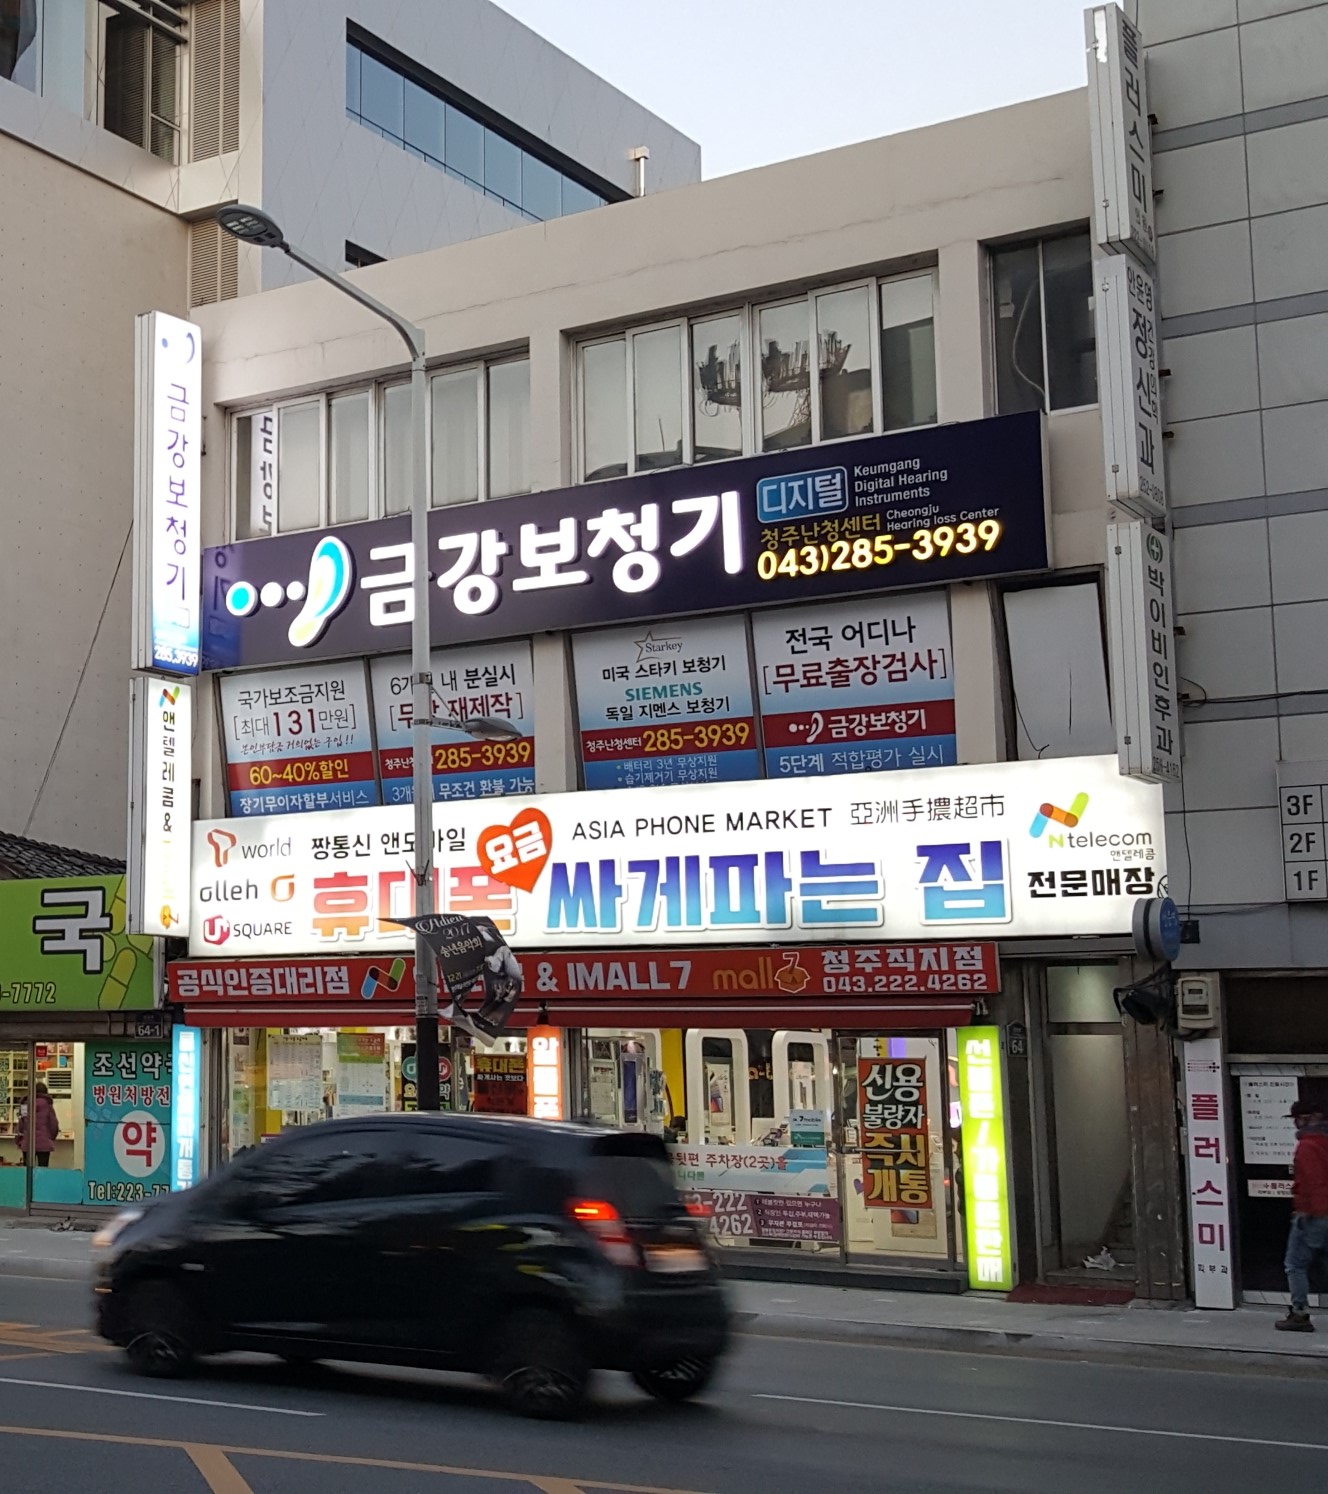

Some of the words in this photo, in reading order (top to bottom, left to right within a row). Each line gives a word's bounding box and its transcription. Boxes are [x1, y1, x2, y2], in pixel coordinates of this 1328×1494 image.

[853, 457, 921, 478] Keumgang
[854, 475, 895, 494] Digital
[898, 468, 949, 487] Hearing
[165, 382, 190, 601] 금강보청기
[761, 472, 843, 515] 디지털
[854, 486, 931, 507] Instruments
[885, 503, 940, 521] Cheongju
[886, 516, 931, 533] Hearing
[934, 514, 957, 527] loss
[959, 506, 1000, 523] Center
[760, 513, 881, 551] 청주난청센터
[360, 489, 744, 628] 금강보청기
[756, 519, 1002, 581] 043)285-3939
[644, 637, 684, 654] Starkey
[784, 625, 833, 656] 전국
[840, 615, 916, 648] 어디나
[602, 664, 630, 683] 미국
[634, 659, 679, 681] 스타키
[682, 654, 727, 676] 보청기
[1148, 565, 1174, 756] 박이비인후과
[463, 663, 516, 688] 분실시
[237, 679, 346, 711] 국가보조금지원
[624, 681, 704, 703] SIEMENS
[605, 704, 635, 723] 독일
[638, 700, 681, 720] 지멘스
[685, 696, 731, 716] 보청기
[826, 708, 928, 739] 금강보청기
[586, 736, 643, 754] 청주난청센터
[642, 722, 751, 753] 285-3939
[435, 741, 532, 770] 285-3939
[623, 759, 654, 773] 배터리
[656, 756, 674, 771] 3년
[676, 754, 718, 769] 무상지원
[778, 751, 825, 775] 5단계
[830, 747, 902, 772] 적합평가
[908, 744, 945, 767] 실시
[249, 758, 350, 786] 60~40%할인
[676, 768, 718, 782] 무상지원
[239, 789, 370, 815] 장기무이자할부서비스
[439, 780, 476, 801] 무조건
[479, 778, 505, 796] 환불
[1286, 794, 1314, 816] 3F
[572, 820, 627, 842] ASIA
[634, 813, 717, 838] PHONE
[725, 807, 833, 833] MARKET
[241, 837, 292, 859] world
[310, 832, 372, 861] 짱통신
[484, 820, 549, 875] 요금
[1289, 832, 1316, 853] 2F
[199, 877, 258, 902] olleh
[545, 849, 884, 931] 싸게파는
[916, 840, 1009, 923] 집
[1027, 866, 1156, 899] 전문매장
[1293, 870, 1318, 891] 1F
[232, 921, 293, 940] SQUARE
[442, 922, 471, 940] 2017
[440, 936, 484, 958] 송년음악회
[820, 946, 985, 975] 청주직지점
[176, 965, 350, 998] 공식인증대리점
[536, 965, 558, 993] &
[712, 955, 774, 991] mall
[822, 972, 989, 994] 043.222.4262
[137, 1024, 161, 1037] 64-1
[476, 1056, 525, 1074] 휴대폰
[861, 1063, 925, 1102] 신용
[861, 1101, 925, 1130] 불량자
[122, 1119, 158, 1168] 약
[863, 1132, 927, 1168] 즉시
[866, 1168, 930, 1206] 개통
[1191, 1093, 1226, 1252] 플러스미
[708, 1213, 754, 1238] 4262
